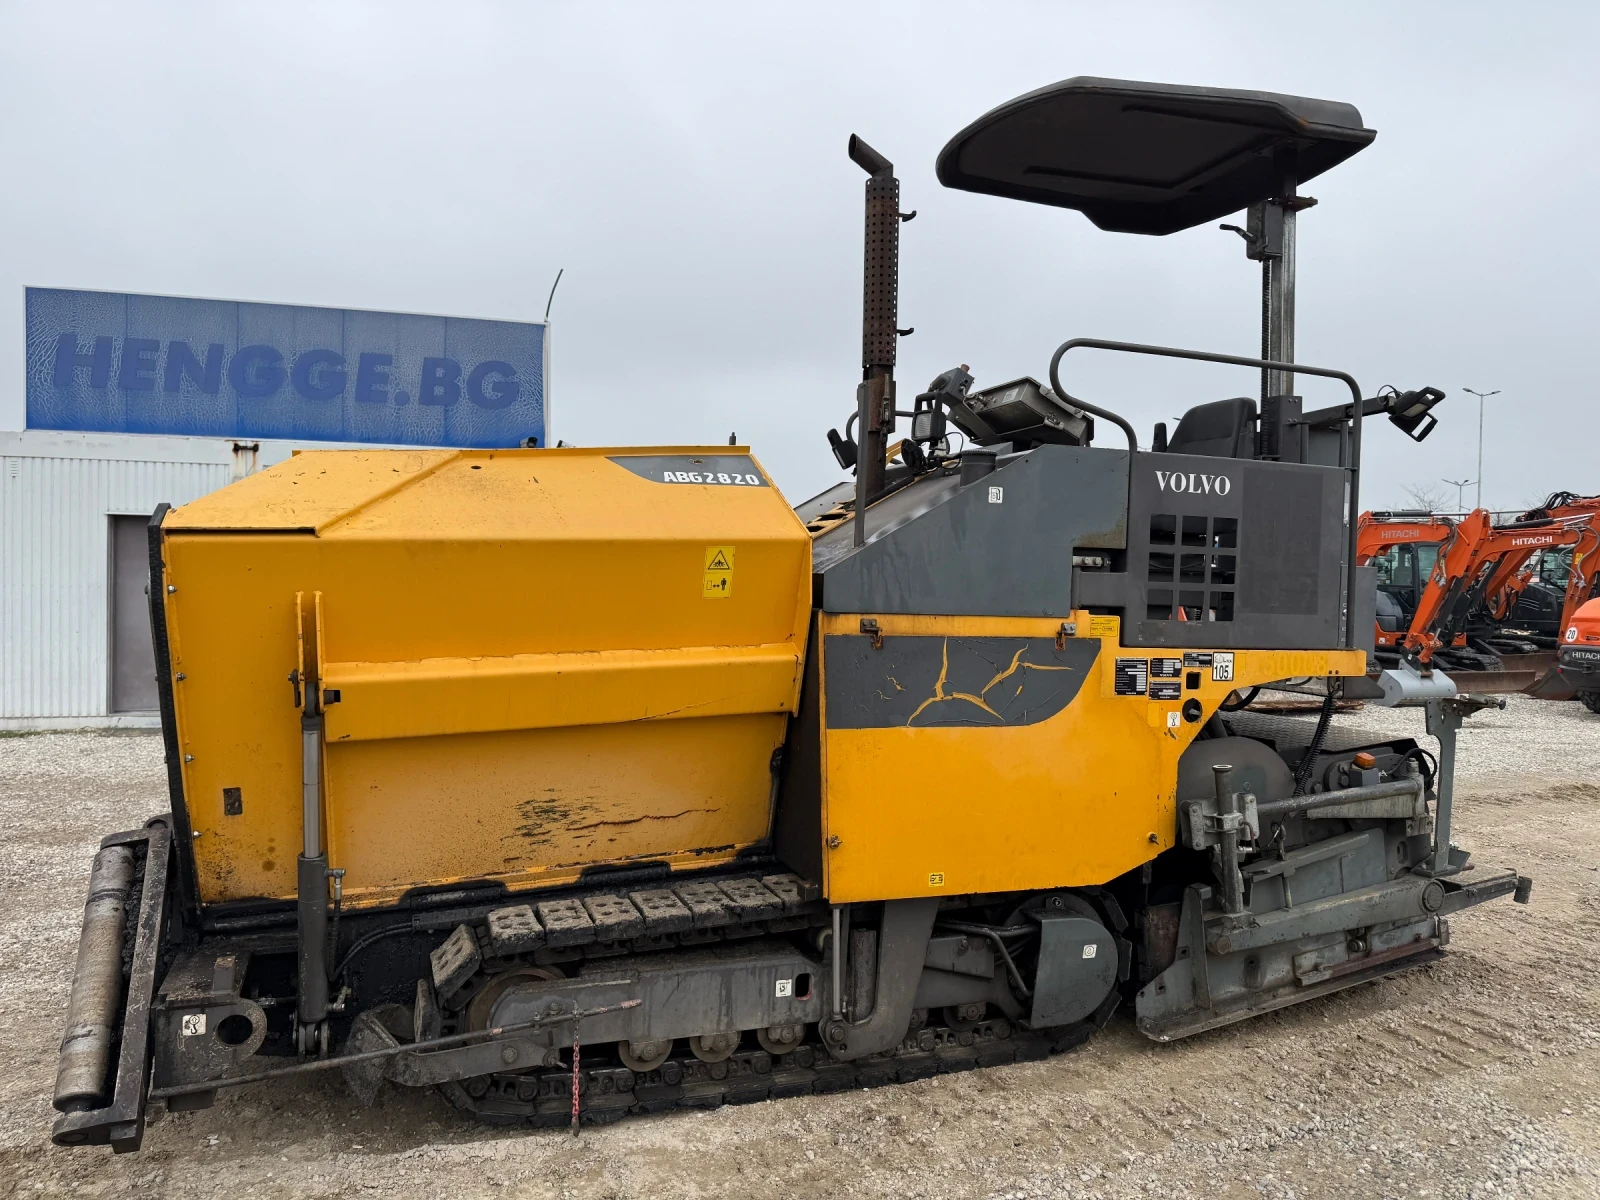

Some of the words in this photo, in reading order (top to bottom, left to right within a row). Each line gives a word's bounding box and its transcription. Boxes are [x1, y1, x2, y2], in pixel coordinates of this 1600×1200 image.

[53, 332, 520, 411] HENGGE.BG
[663, 471, 760, 486] ABG2820
[1154, 470, 1231, 496] VOLVO
[1381, 529, 1420, 539] HITACHI
[1512, 535, 1553, 546] HITACHI
[1567, 629, 1576, 640] 20
[1214, 665, 1229, 680] 105
